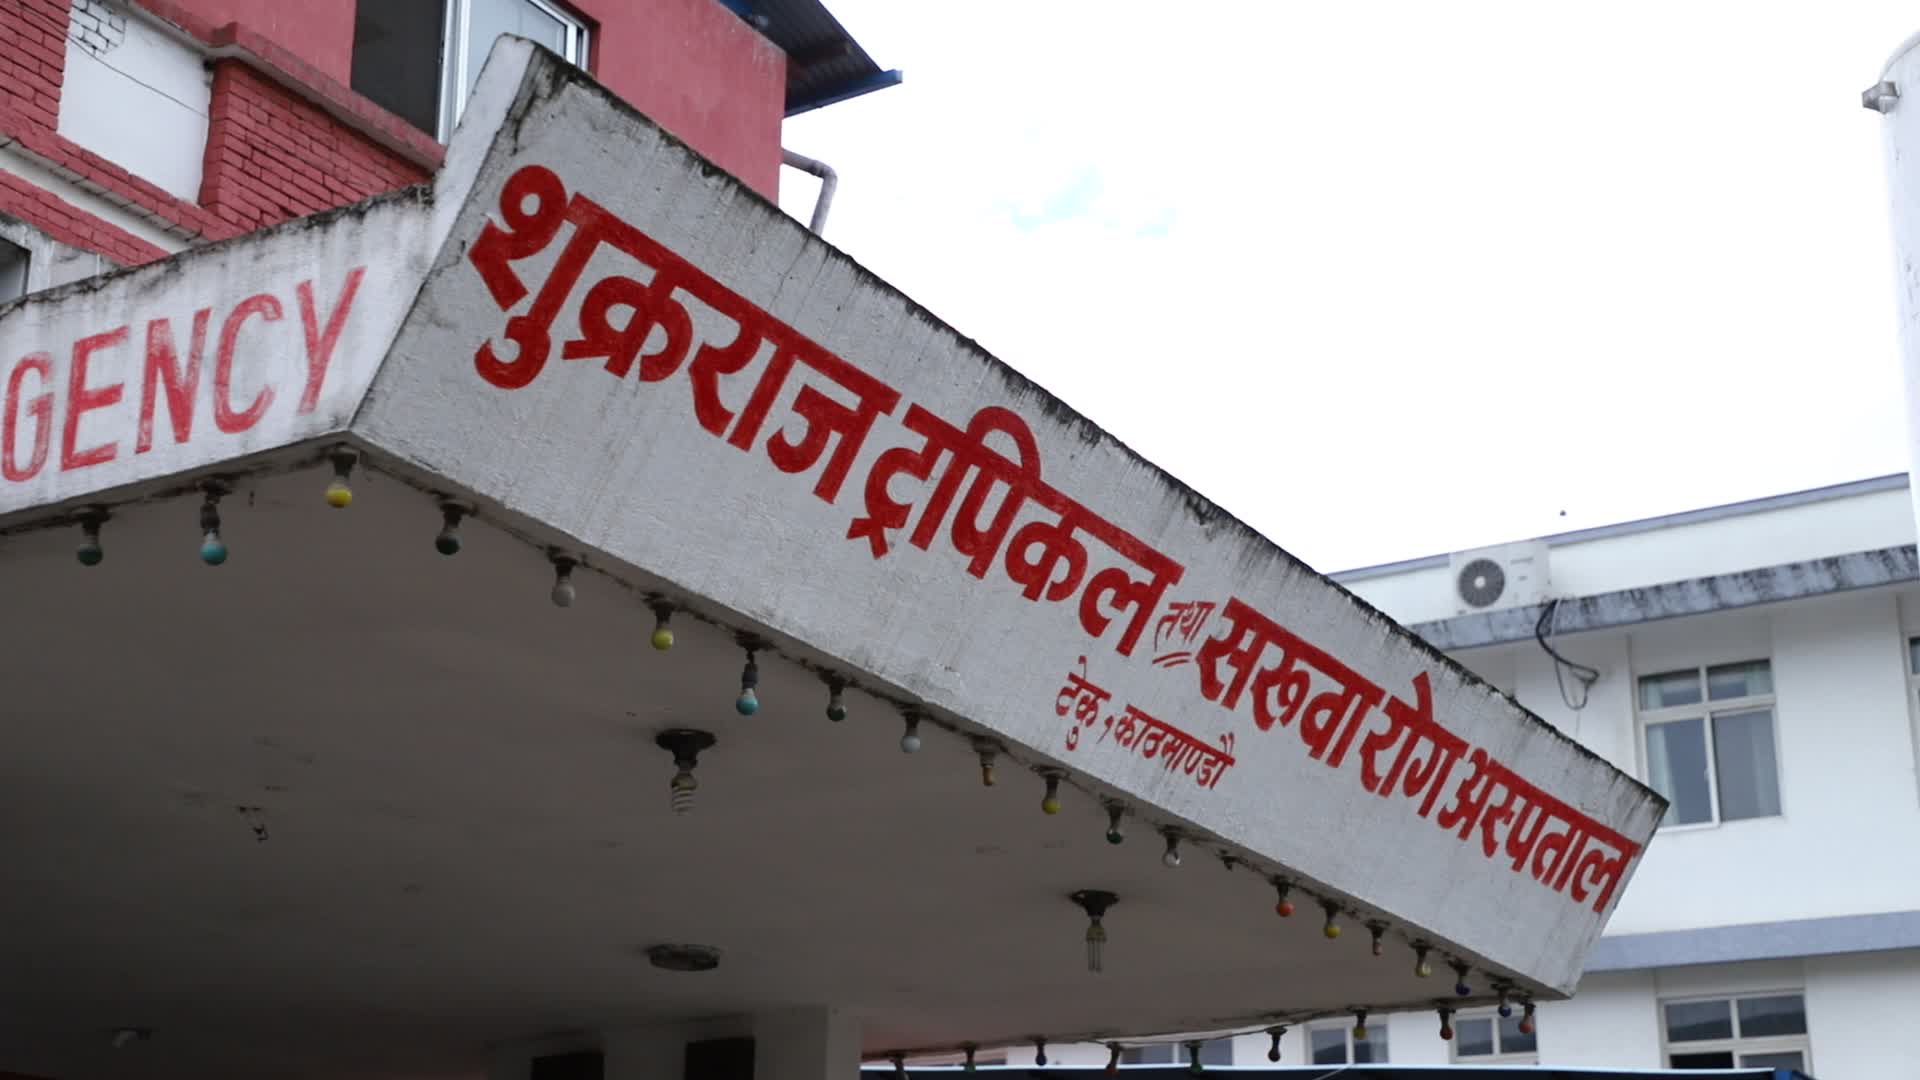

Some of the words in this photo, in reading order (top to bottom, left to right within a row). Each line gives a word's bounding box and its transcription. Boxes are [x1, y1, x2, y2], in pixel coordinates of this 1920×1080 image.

[1, 266, 366, 483] GENCY
[468, 165, 902, 504] शुक्रराज
[1154, 601, 1217, 652] तथा
[1359, 671, 1470, 817] रोग
[1437, 748, 1641, 913] अस्पताल
